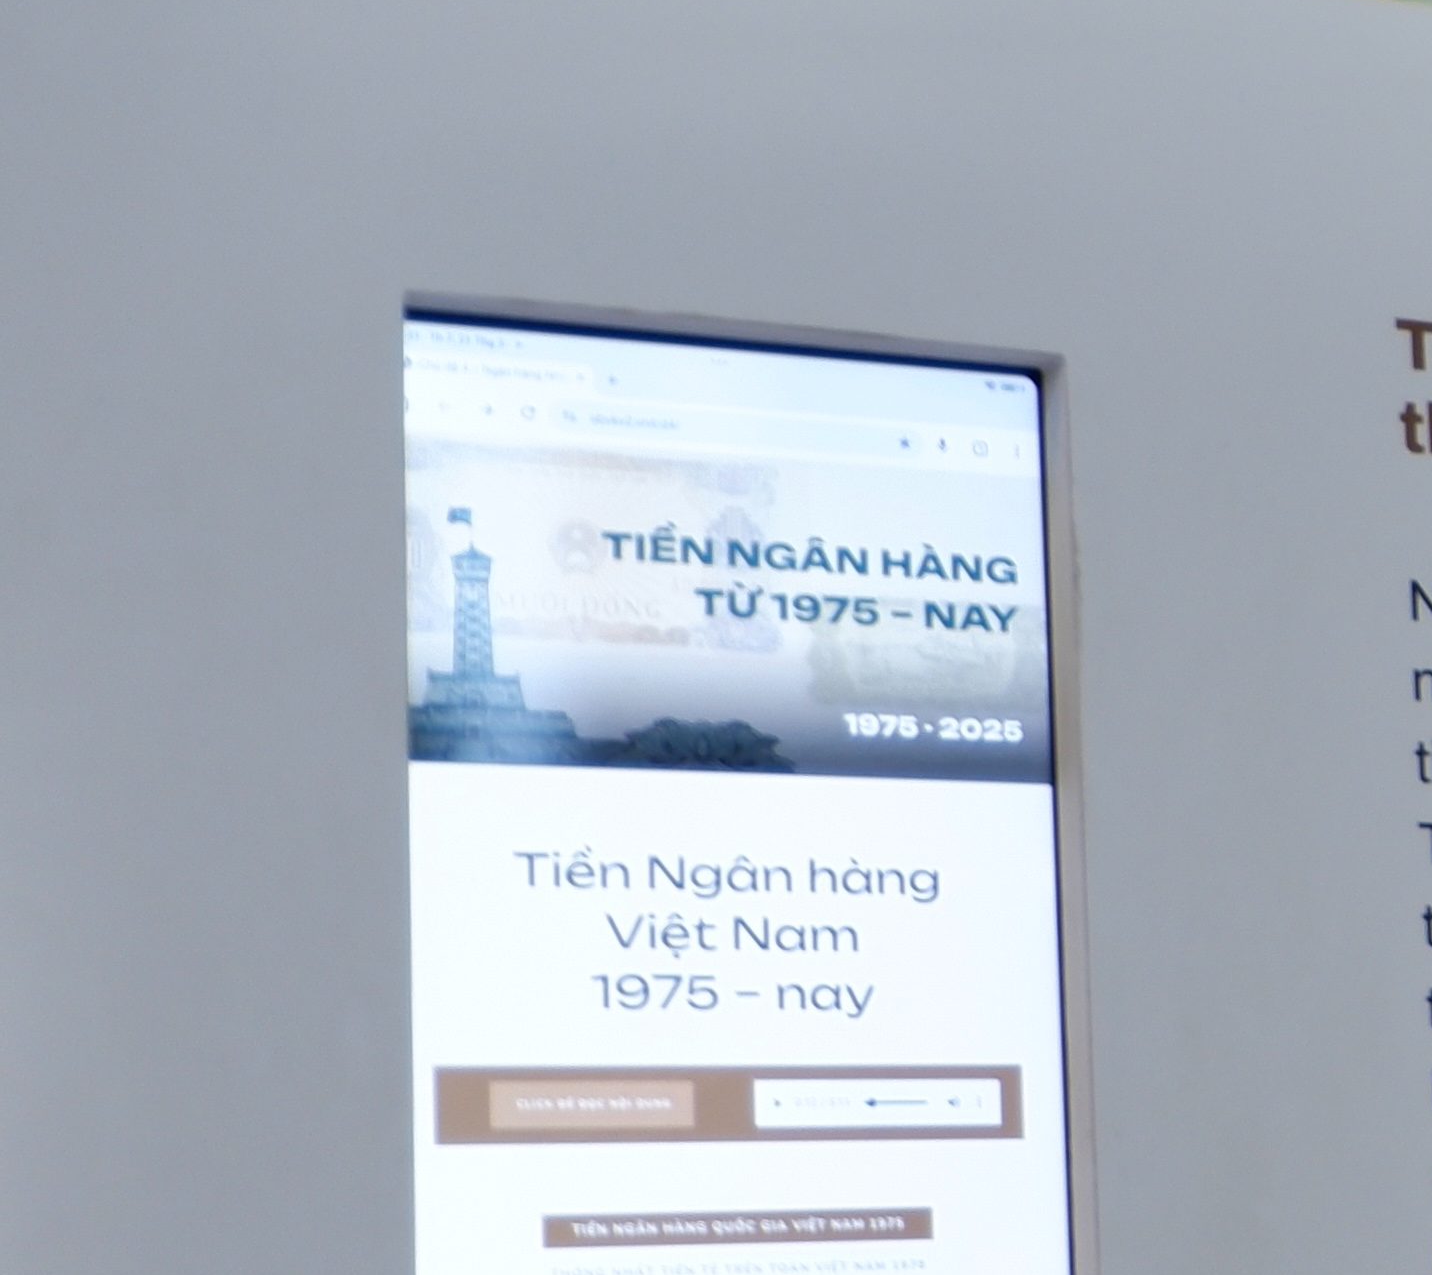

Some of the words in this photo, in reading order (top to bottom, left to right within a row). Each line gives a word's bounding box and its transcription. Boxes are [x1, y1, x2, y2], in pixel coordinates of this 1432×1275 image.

[602, 520, 714, 566] TIỀN
[727, 537, 869, 576] NGÂN
[881, 542, 1019, 585] HÀNG
[696, 580, 763, 619] TỪ
[772, 592, 880, 626] 1975
[923, 601, 1019, 633] NAY
[843, 711, 920, 739] 1975
[938, 715, 1025, 743] 2025
[513, 844, 631, 890] Tiền
[647, 854, 793, 900] Ngân
[808, 856, 940, 904] hàng
[605, 913, 718, 959] Việt
[732, 916, 861, 953] Nam
[591, 972, 720, 1012] 1975
[776, 982, 875, 1020] nay
